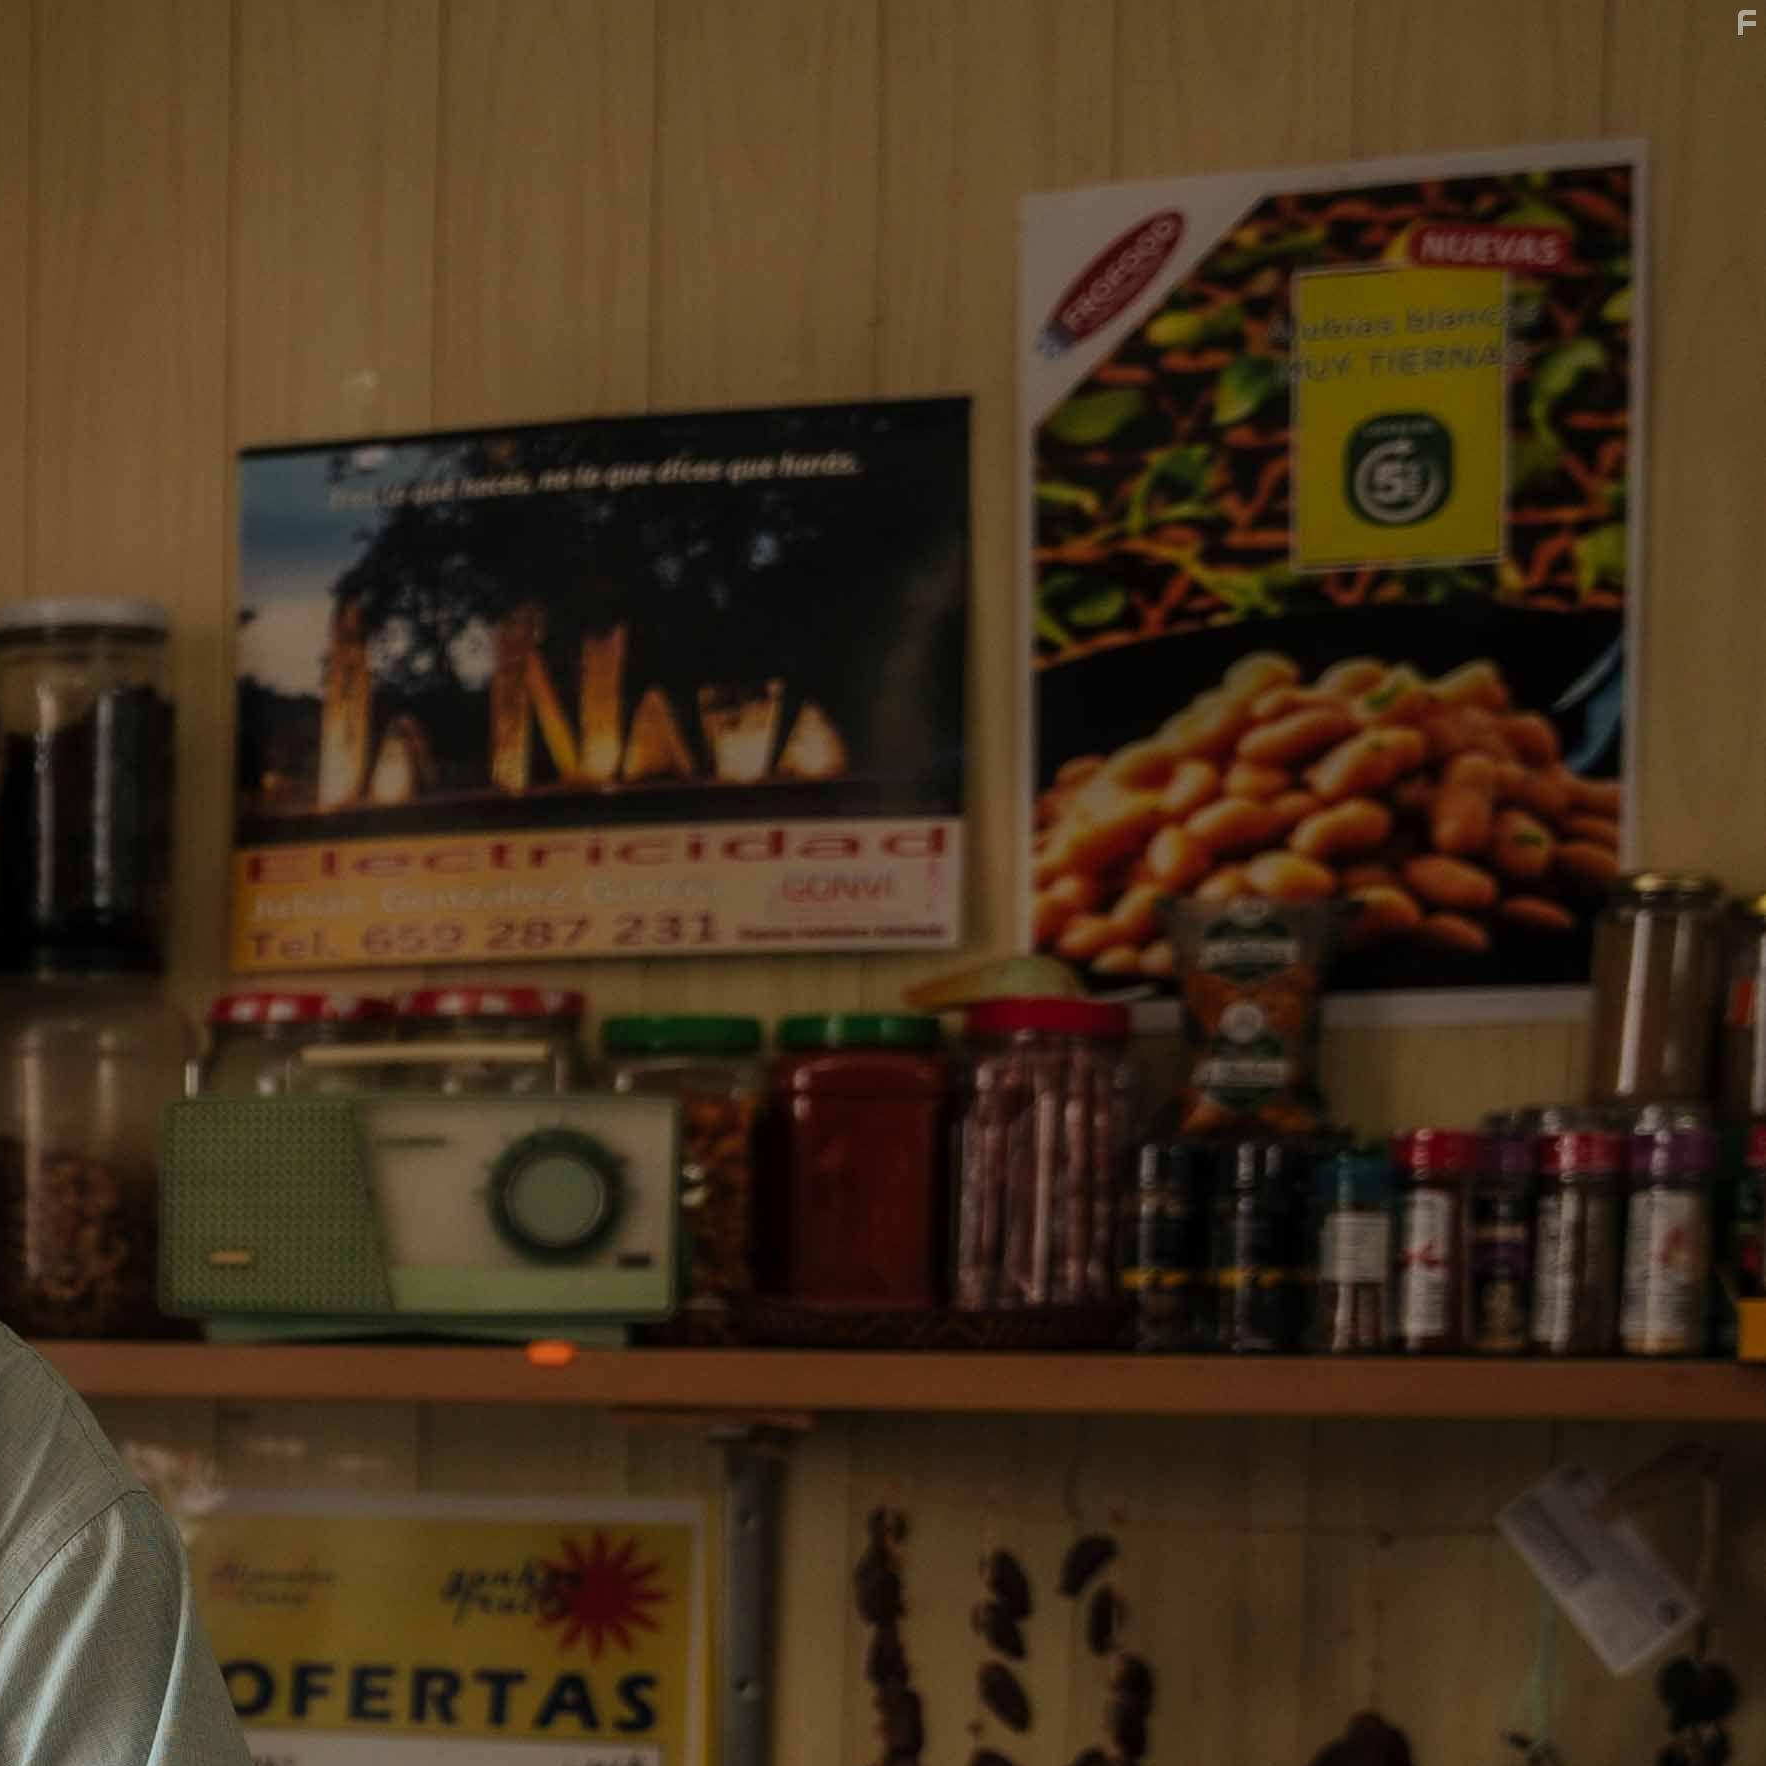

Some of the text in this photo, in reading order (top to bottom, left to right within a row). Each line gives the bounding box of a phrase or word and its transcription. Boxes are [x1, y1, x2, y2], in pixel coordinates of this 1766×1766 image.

[1419, 230, 1561, 264] NUEVAS
[1366, 339, 1530, 377] TIERNAS
[245, 826, 946, 884] Electricidad
[248, 929, 339, 963] Tel.
[361, 919, 467, 957] 659
[485, 915, 592, 951] 287
[613, 909, 720, 947] 231
[218, 1656, 659, 1735] OFERTAS
